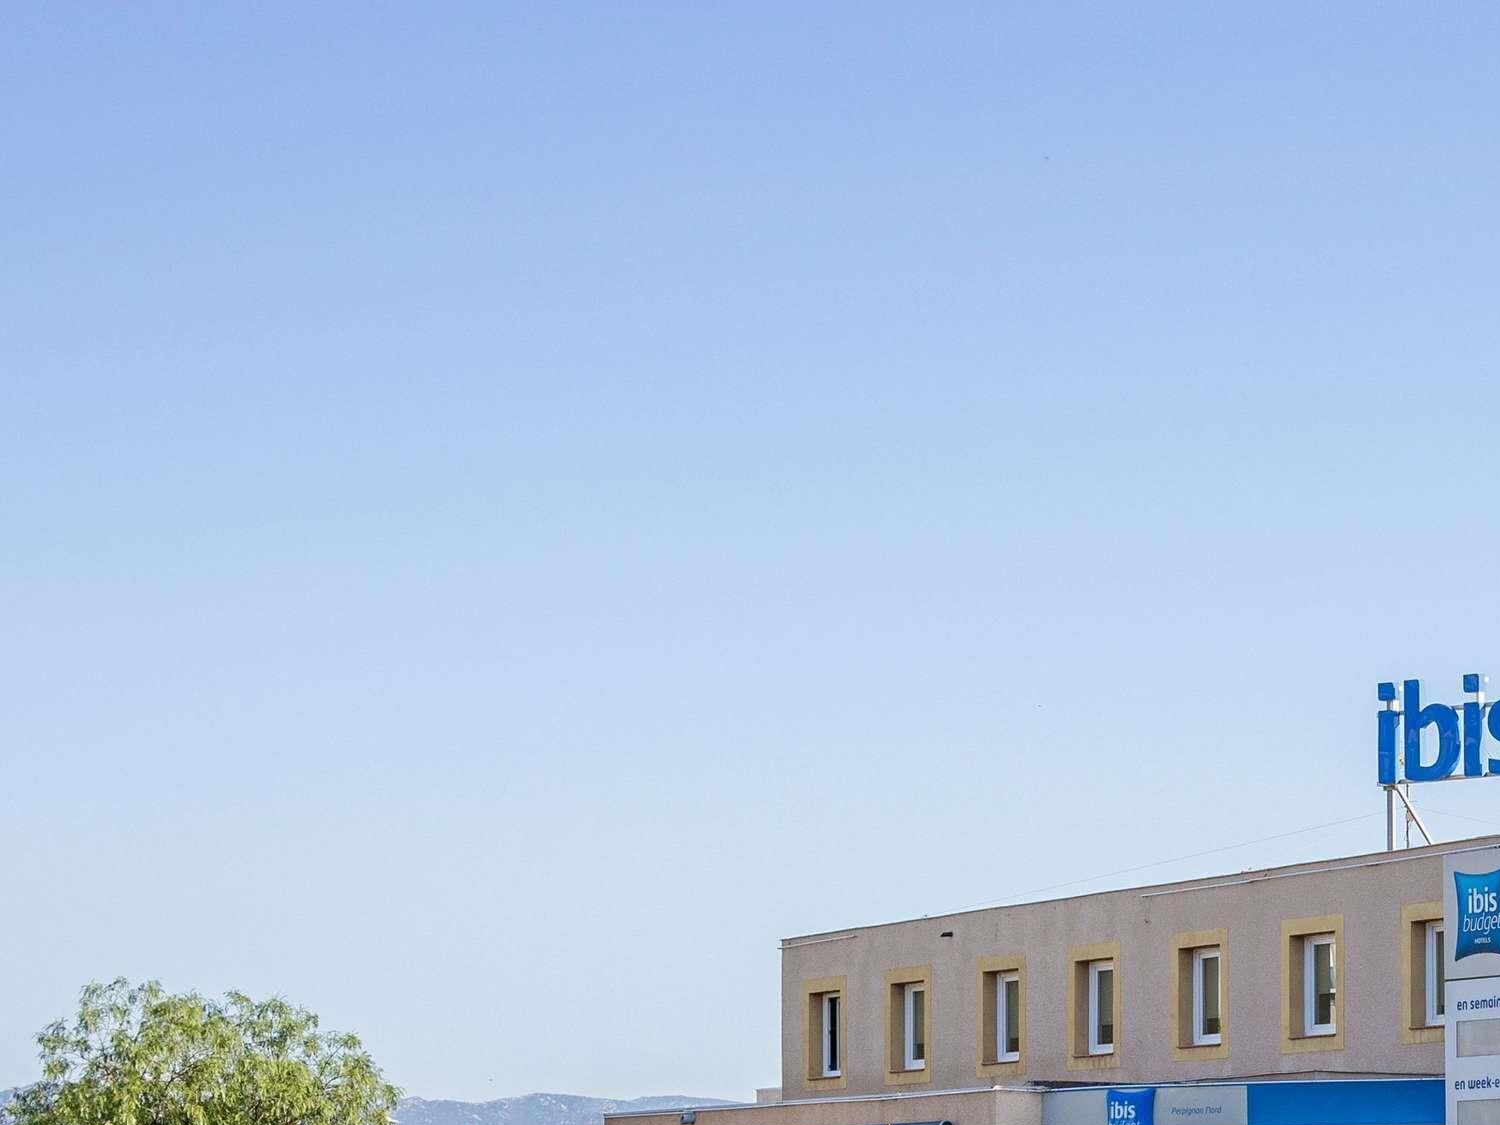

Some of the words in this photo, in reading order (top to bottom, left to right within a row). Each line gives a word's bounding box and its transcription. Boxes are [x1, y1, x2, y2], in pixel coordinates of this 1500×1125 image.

[1468, 886, 1498, 914] ibis
[1456, 1000, 1468, 1011] en
[1454, 1080, 1465, 1090] en
[1110, 1100, 1136, 1119] ibis
